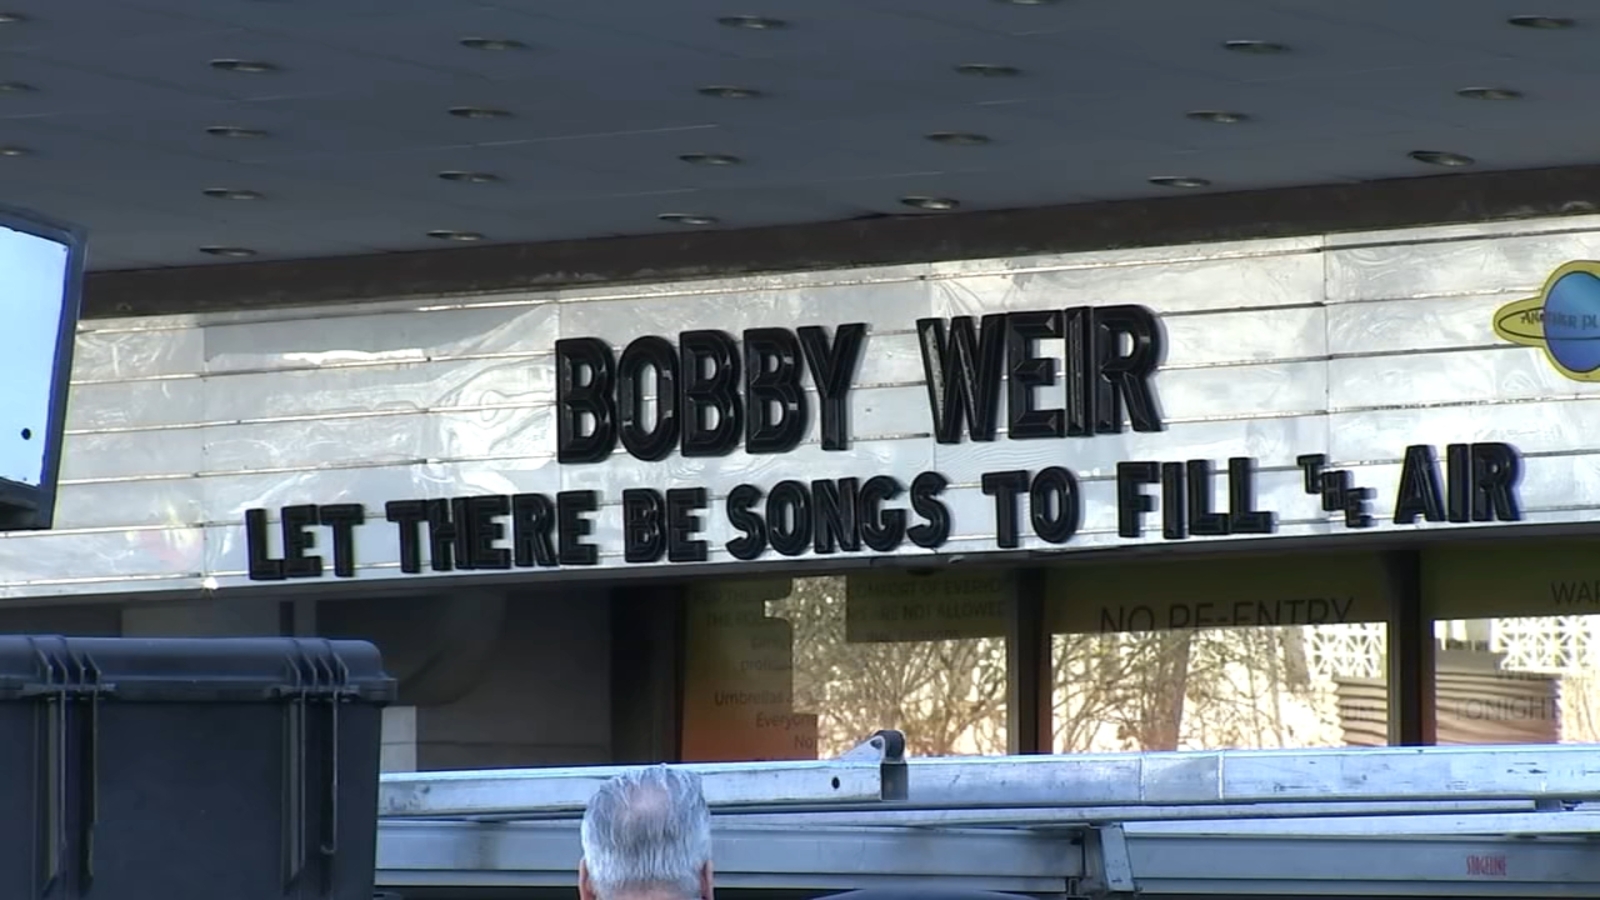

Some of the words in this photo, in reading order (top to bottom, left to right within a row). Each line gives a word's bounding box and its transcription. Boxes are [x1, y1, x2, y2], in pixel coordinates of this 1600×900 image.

[556, 323, 868, 463] BOBBY
[917, 304, 1168, 443] WEIR
[246, 503, 364, 580] LET
[386, 490, 597, 573] THERE
[623, 487, 708, 563] BE
[725, 471, 951, 560] SONGS
[982, 466, 1080, 549] TO
[1117, 457, 1277, 539] FILL
[1297, 454, 1376, 527] THE
[1393, 442, 1522, 523] AIR
[902, 603, 932, 621] NOT
[1101, 605, 1155, 632] NO
[1169, 598, 1354, 630] RE-ENTRY
[714, 688, 784, 706] Umbrellas
[1455, 696, 1557, 722] TONIGHT
